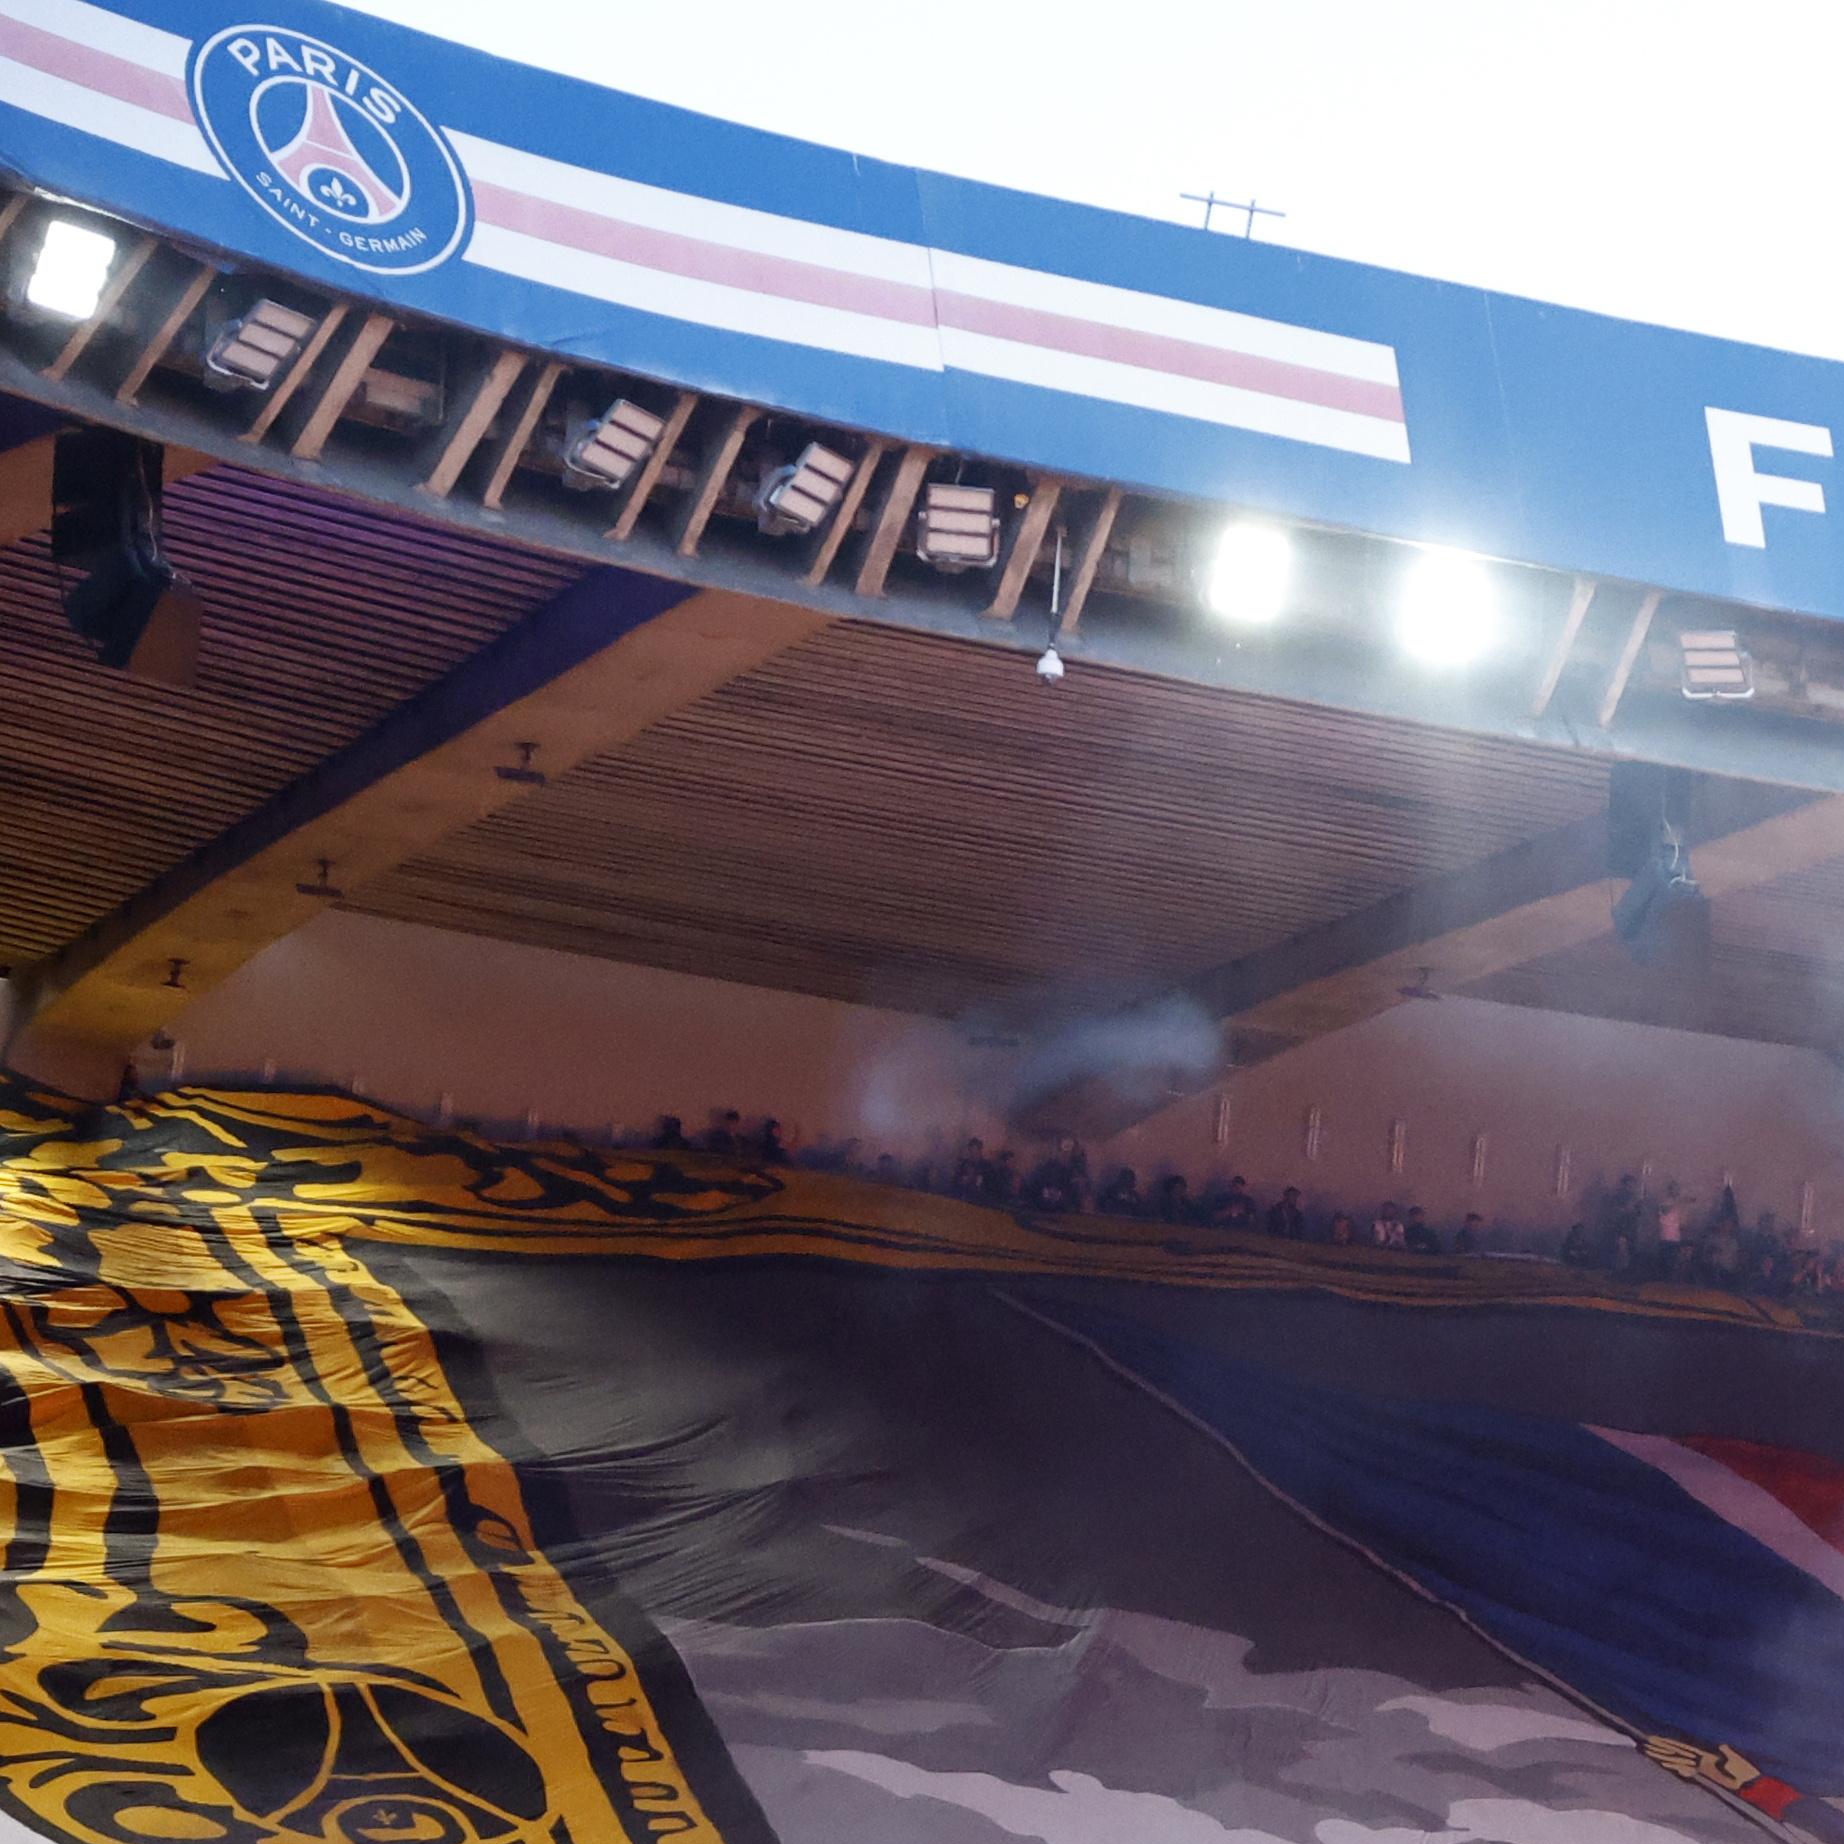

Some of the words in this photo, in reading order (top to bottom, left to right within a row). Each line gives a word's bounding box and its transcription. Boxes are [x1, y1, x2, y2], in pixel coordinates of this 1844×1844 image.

[227, 36, 402, 124] PARIS
[255, 170, 321, 229] SAINT
[338, 227, 427, 254] GERMAIN
